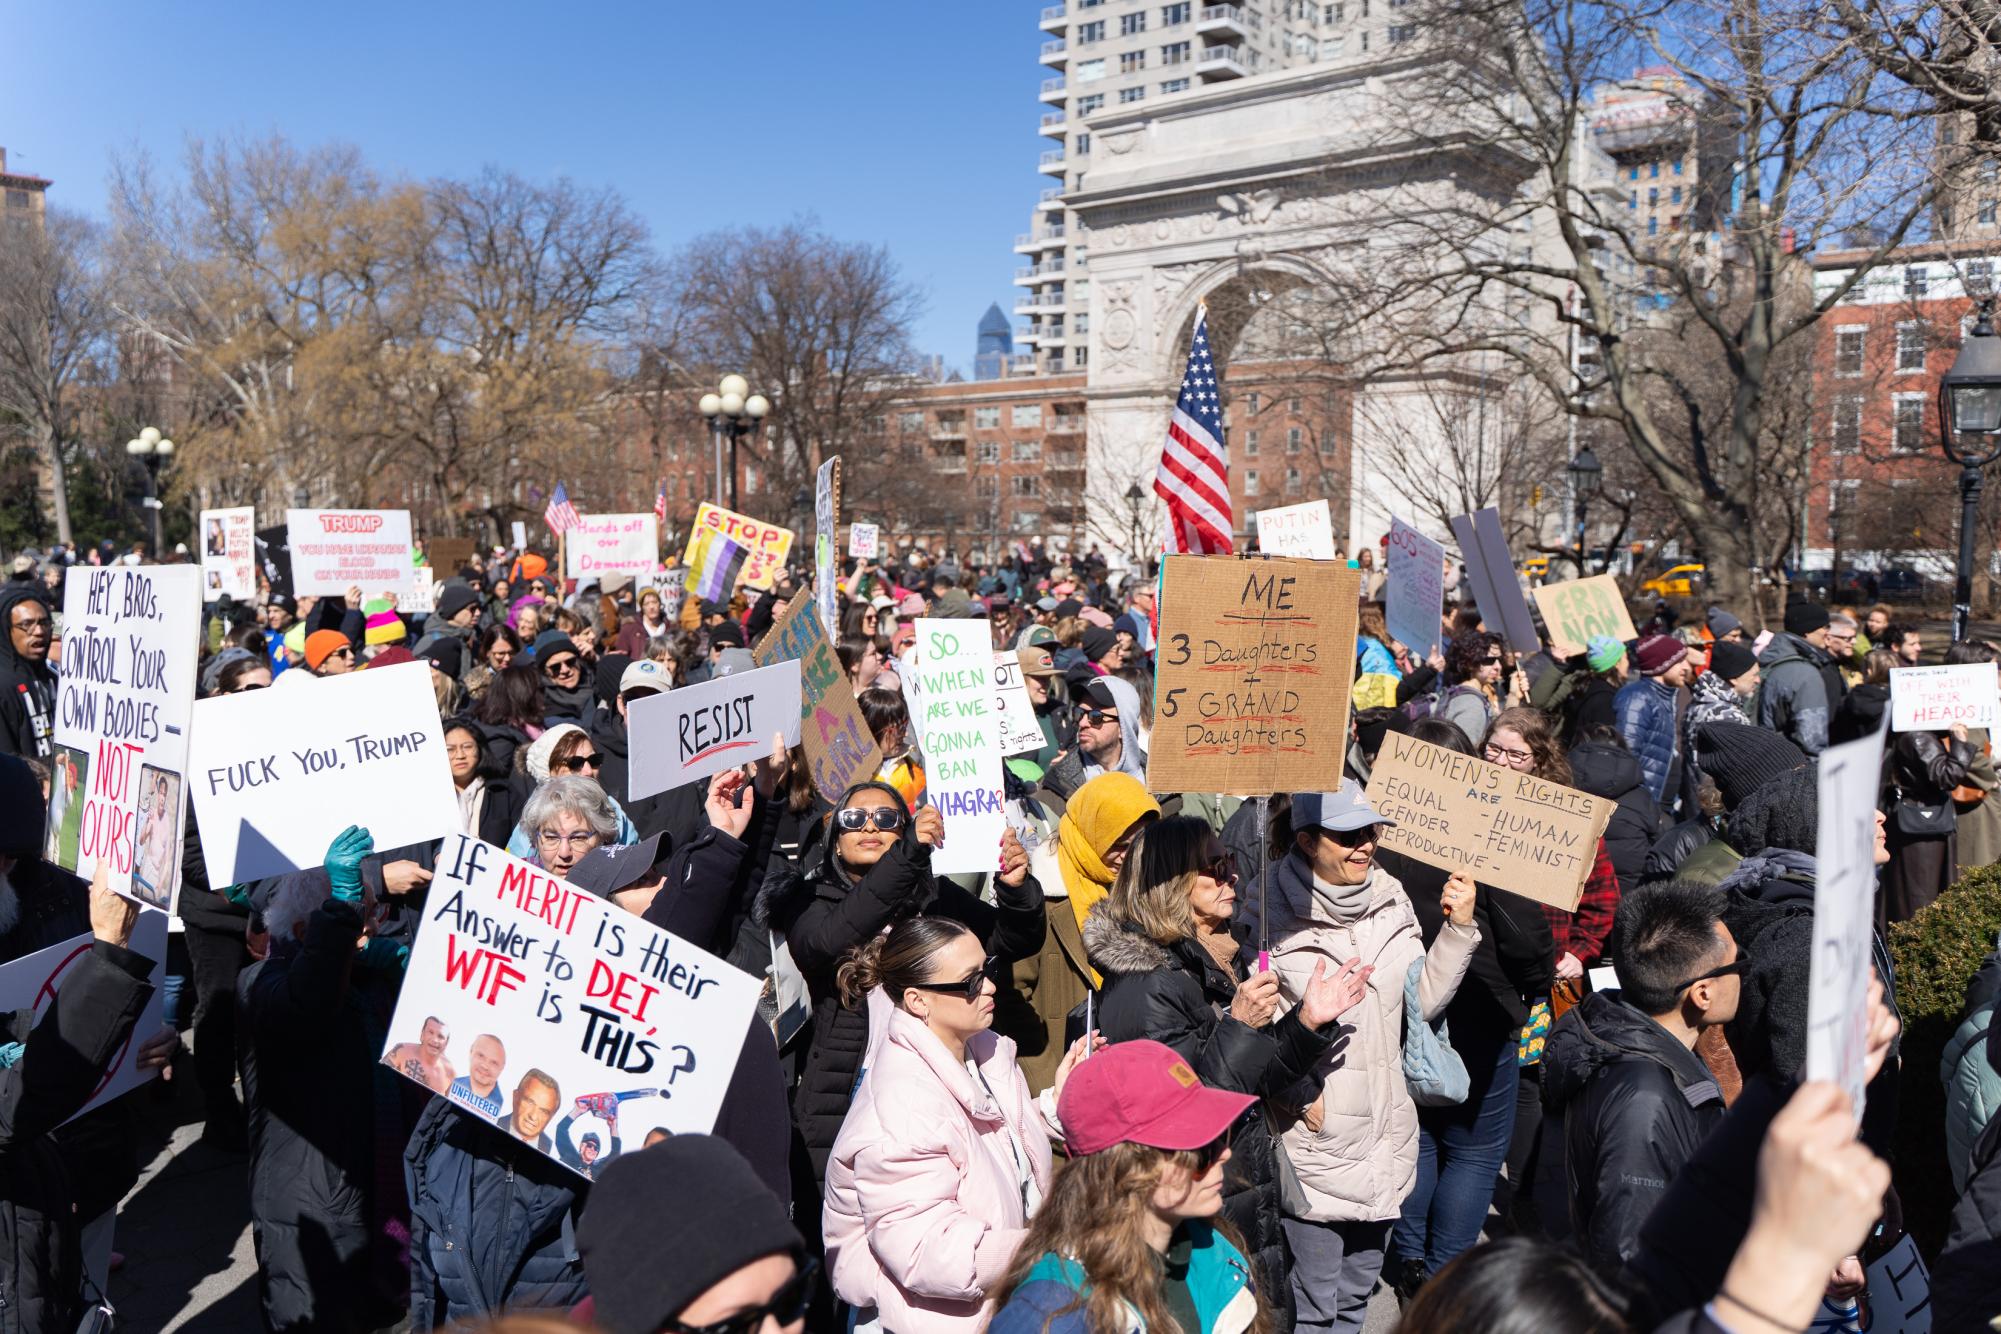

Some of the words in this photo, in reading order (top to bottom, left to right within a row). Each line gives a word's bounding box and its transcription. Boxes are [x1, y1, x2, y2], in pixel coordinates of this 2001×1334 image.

[319, 514, 383, 533] TRUMP
[577, 520, 618, 534] Hands
[624, 520, 643, 533] off
[707, 511, 779, 548] STOP
[1263, 510, 1319, 530] PUTIN
[299, 544, 324, 555] YOU
[598, 540, 620, 548] our
[1391, 523, 1417, 557] 605
[333, 569, 366, 581] YOUR
[581, 554, 652, 573] Democracy
[653, 574, 682, 586] MAKE
[87, 570, 119, 624] HEY,
[1241, 572, 1296, 610] ME
[1555, 584, 1612, 620] ERA
[1562, 607, 1620, 645] NOW
[60, 625, 121, 686] CONTROL
[130, 634, 169, 693] YOUR
[1168, 633, 1192, 665] 3
[1204, 632, 1317, 675] Daughters
[923, 668, 985, 695] WHEN
[1920, 692, 1960, 704] THEIR
[1937, 677, 1971, 689] WITH
[63, 684, 97, 734] OWN
[927, 701, 952, 722] ARE
[956, 698, 988, 718] WE
[1161, 688, 1187, 718] 5
[1199, 690, 1300, 719] GRAND
[679, 694, 754, 762] RESIST
[815, 707, 840, 745] A
[1185, 720, 1306, 755] Daughters
[815, 714, 874, 801] GIRL
[925, 730, 986, 759] GONNA
[95, 739, 144, 803] NOT
[207, 755, 280, 796] FUCK
[291, 748, 346, 775] YOU,
[345, 731, 427, 764] TRUMP
[937, 758, 977, 781] BAN
[1394, 735, 1501, 789] WOMEN'S
[1516, 776, 1593, 814] RIGHTS
[930, 787, 1005, 817] VIAGRA?
[1466, 788, 1501, 804] ARE
[81, 800, 135, 875] OURS
[446, 833, 488, 886] If
[497, 863, 595, 935] MERIT
[594, 911, 626, 957] is
[640, 933, 720, 1000] their
[434, 890, 539, 960] Answer
[543, 939, 573, 981] to
[586, 958, 660, 1036] DEI,
[446, 933, 527, 1006] WTF
[537, 982, 563, 1024] is
[451, 1083, 499, 1118] UNFILTERED
